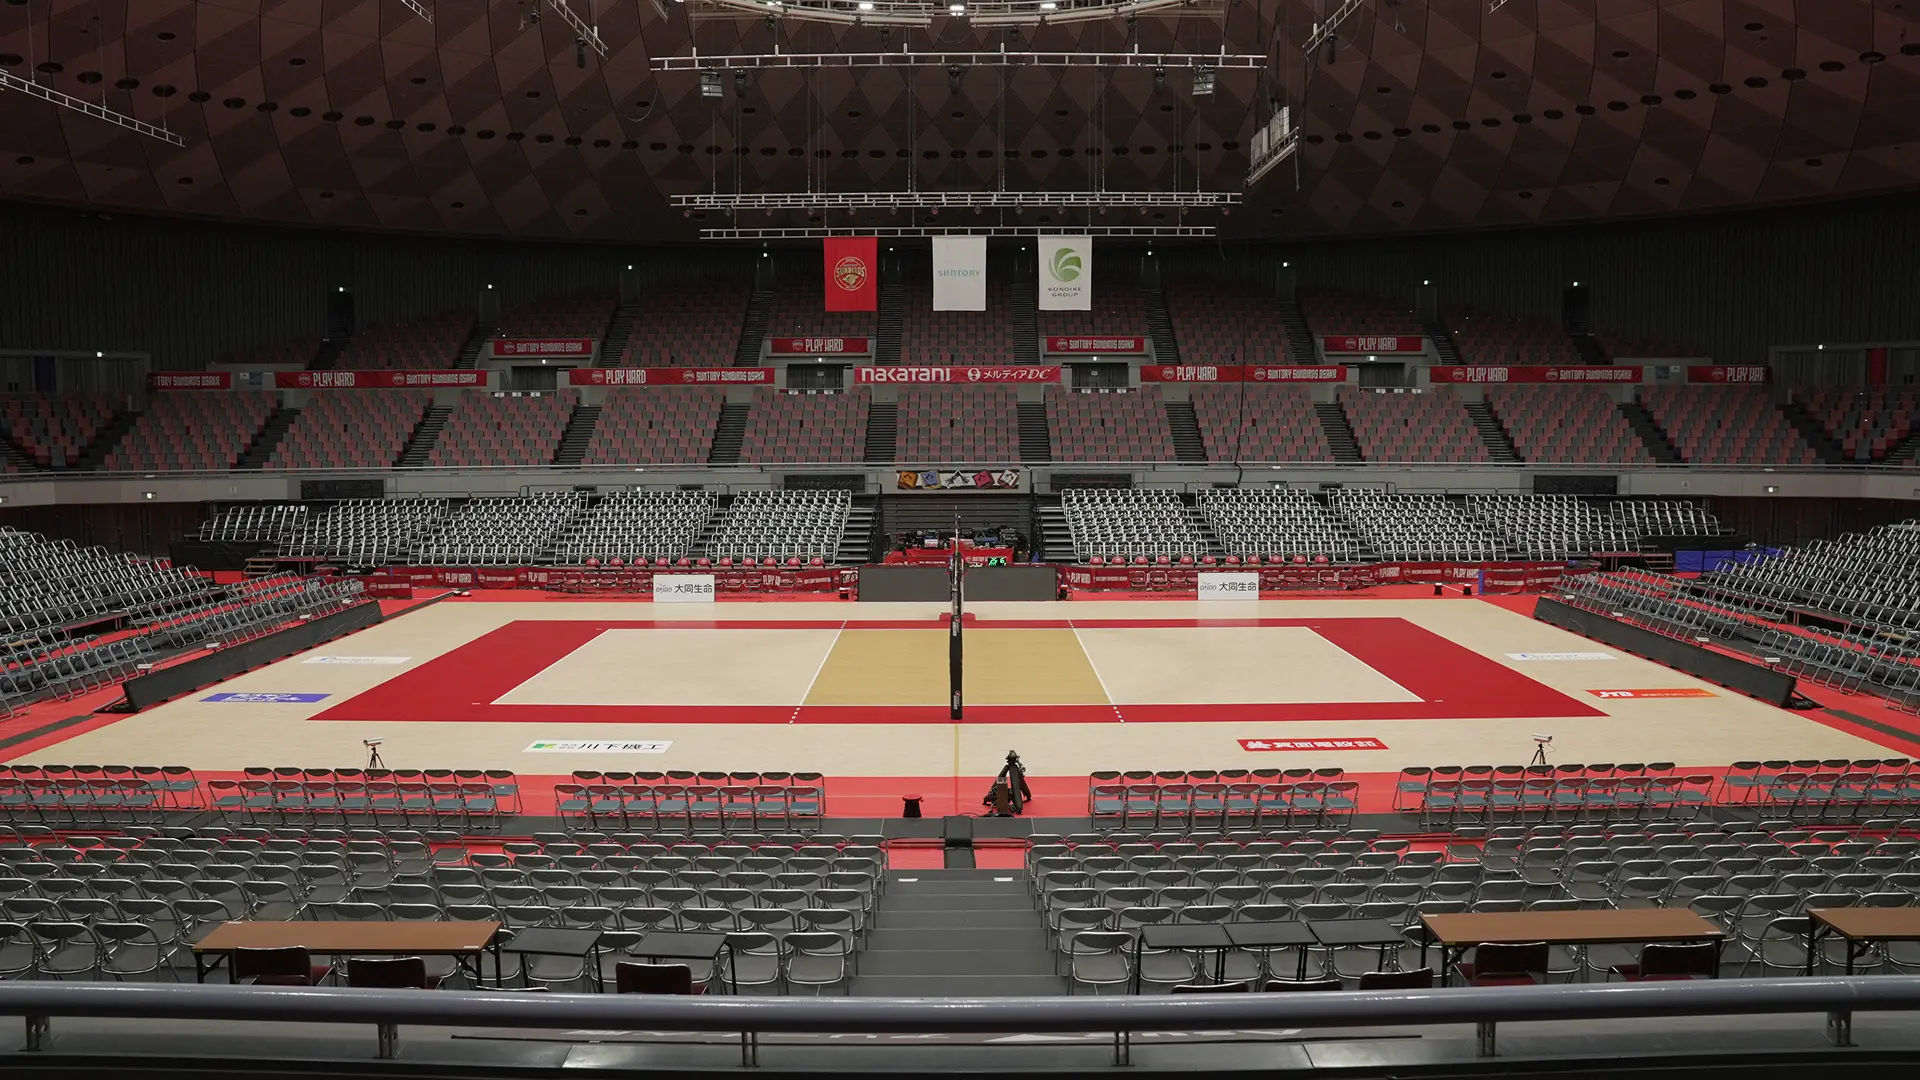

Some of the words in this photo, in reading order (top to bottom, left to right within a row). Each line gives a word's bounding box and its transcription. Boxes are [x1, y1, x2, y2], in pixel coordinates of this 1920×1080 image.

[837, 266, 865, 278] SUNBIRDS
[938, 269, 981, 277] SUNTORY
[516, 342, 539, 352] SUNTORY
[566, 342, 583, 352] OSAKA
[805, 339, 824, 352] PLAY
[824, 338, 844, 352] HARD
[1069, 339, 1093, 349] SUNTORY
[1118, 339, 1135, 349] OSAKA
[1359, 337, 1377, 351] PLAY
[1378, 337, 1397, 351] HARD
[313, 372, 333, 387] PLAY
[334, 371, 355, 387] HARD
[406, 373, 432, 384] SUNTORY
[459, 373, 477, 384] OSAKA
[605, 369, 625, 385] PLAY
[626, 369, 646, 384] HARD
[696, 371, 721, 381] SUNTORY
[747, 370, 765, 381] OSAKA
[1176, 366, 1196, 381] PLAY
[1197, 366, 1217, 380] HARD
[1267, 369, 1292, 379] SUNTORY
[1466, 367, 1487, 382] PLAY
[1487, 367, 1508, 382] HARD
[1559, 369, 1585, 380] SUNTORY
[1613, 369, 1632, 380] OSAKA
[1726, 366, 1748, 382] PLAY
[201, 375, 220, 386] OSAKA
[674, 583, 713, 594] 大同生命
[1218, 581, 1257, 592] 大同生命
